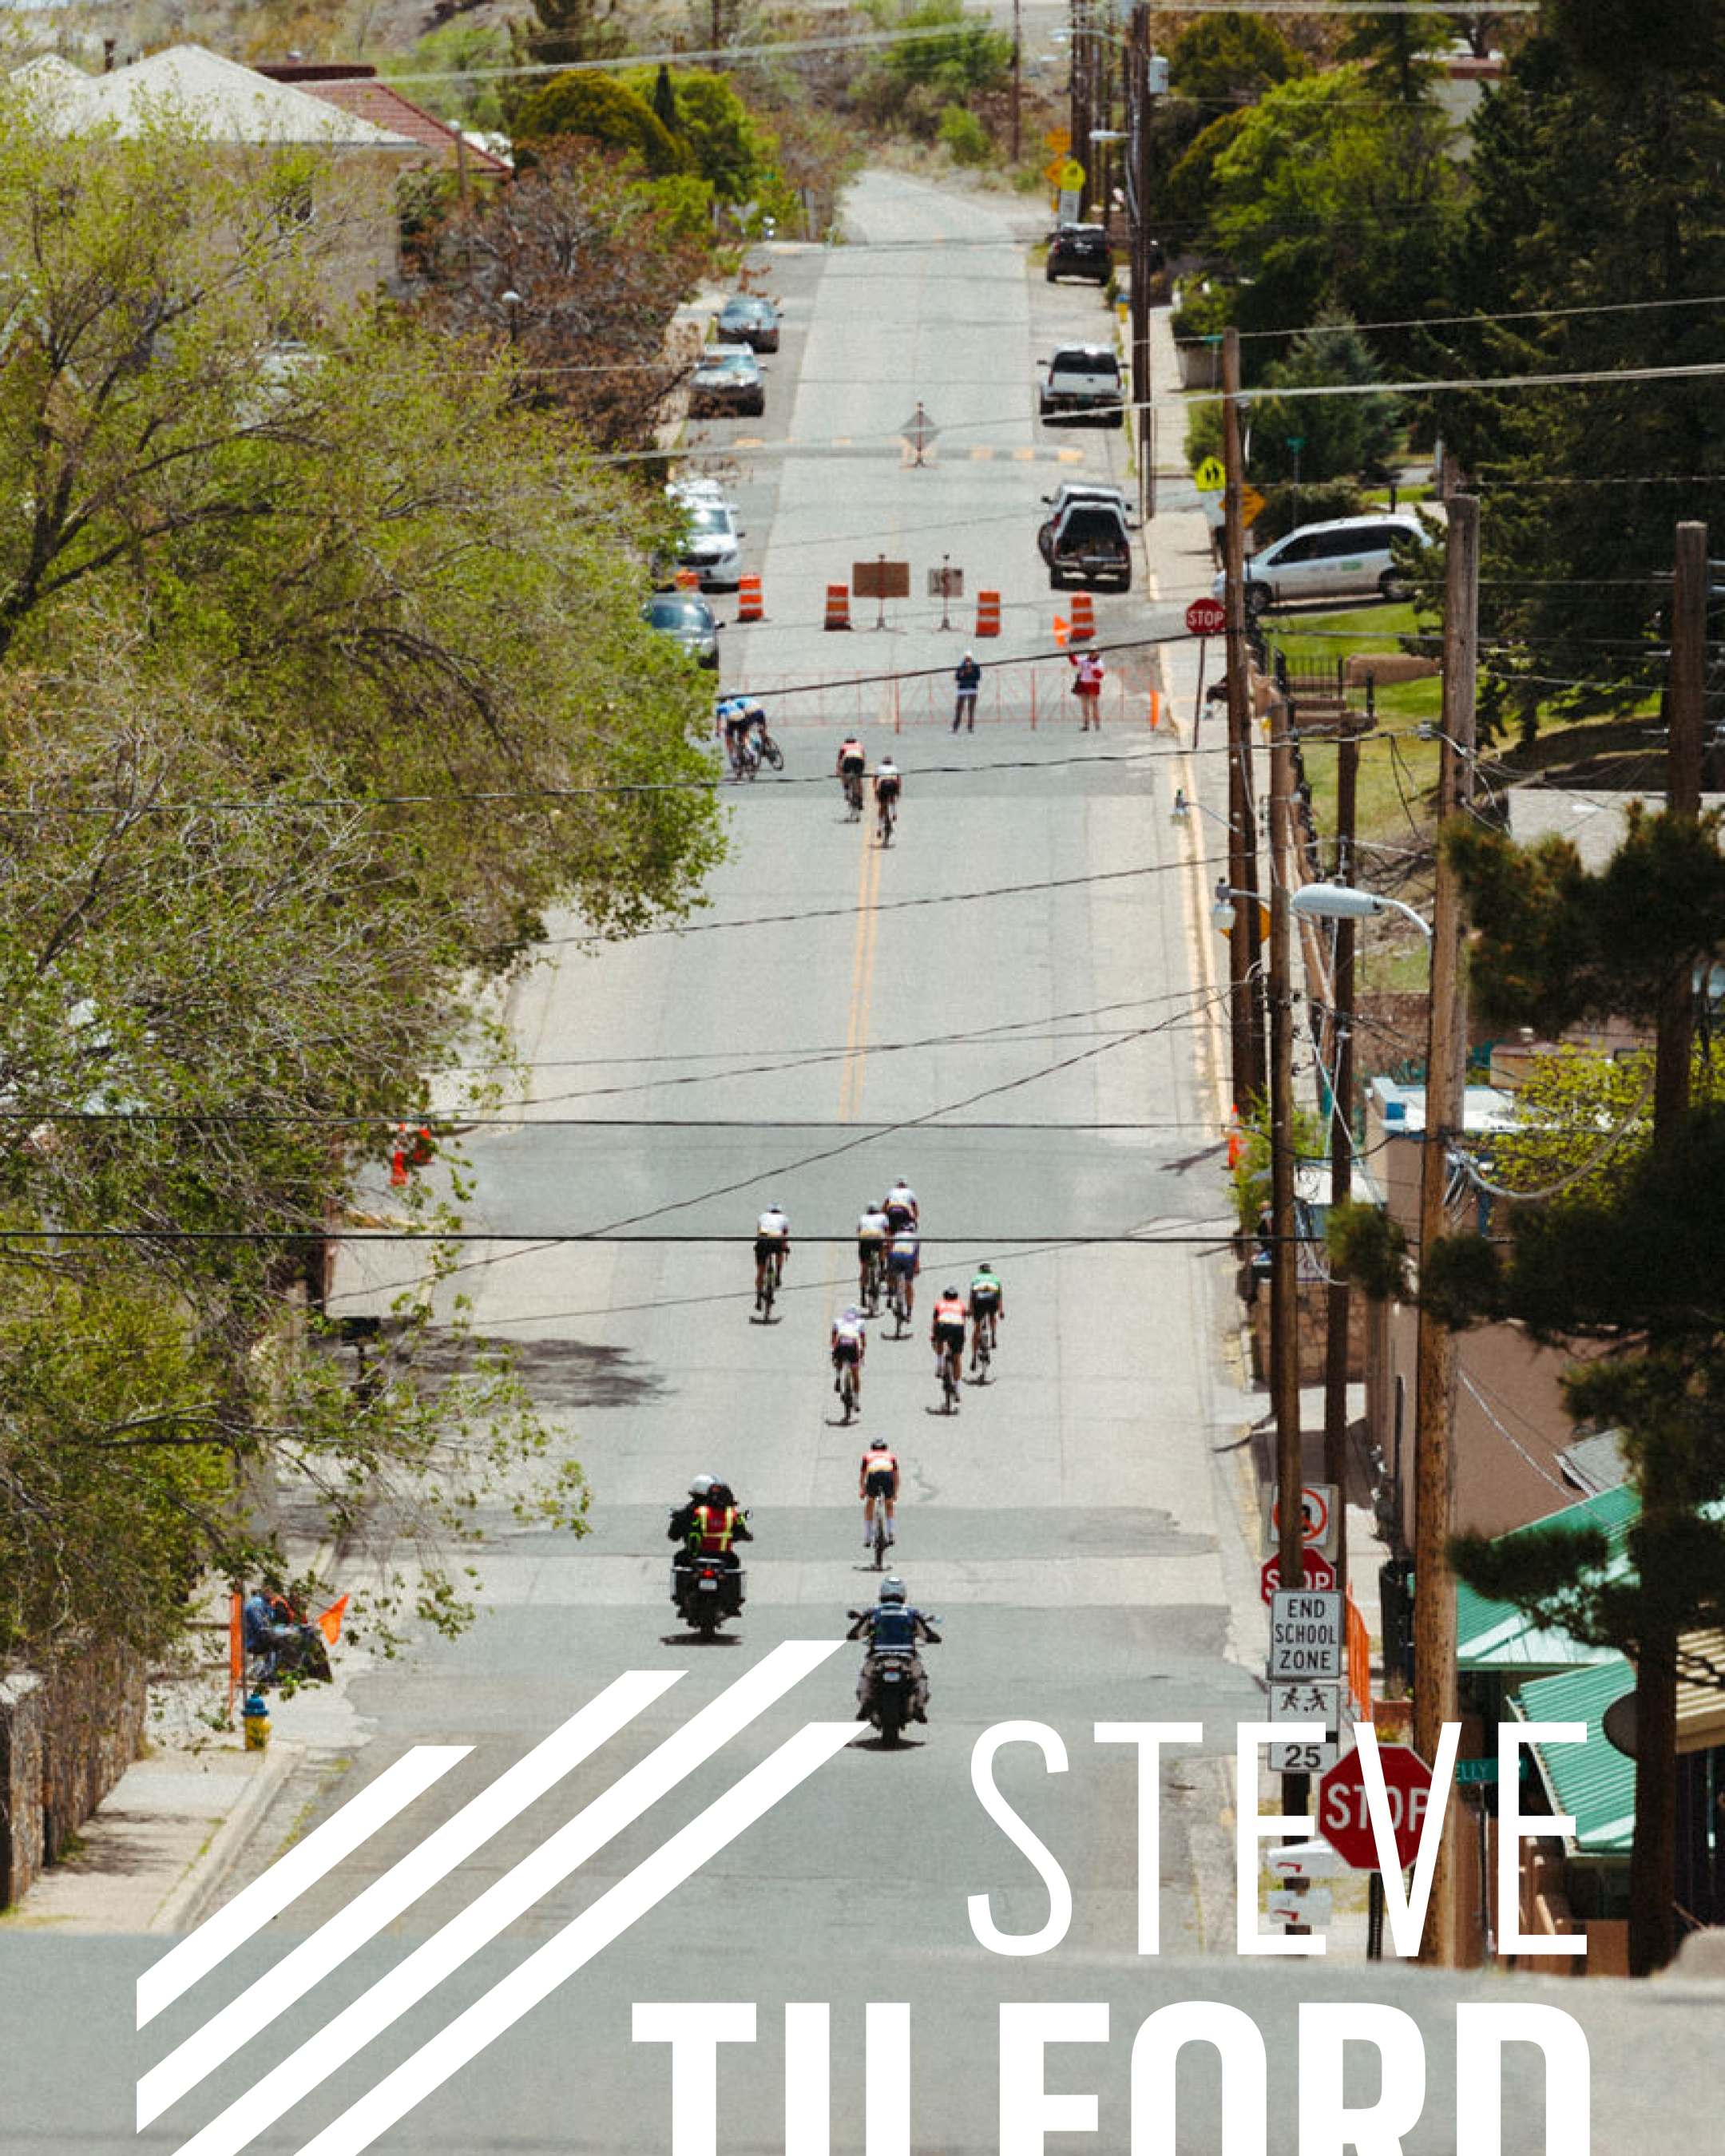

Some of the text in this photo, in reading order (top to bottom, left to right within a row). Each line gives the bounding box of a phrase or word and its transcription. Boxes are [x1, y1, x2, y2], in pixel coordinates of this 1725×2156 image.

[1188, 611, 1224, 624] STOP
[1265, 1568, 1330, 1597] SP
[1287, 1599, 1325, 1618] END
[1275, 1623, 1337, 1644] SCHOOL
[1279, 1649, 1331, 1671] ZONE
[1285, 1745, 1321, 1768] 25
